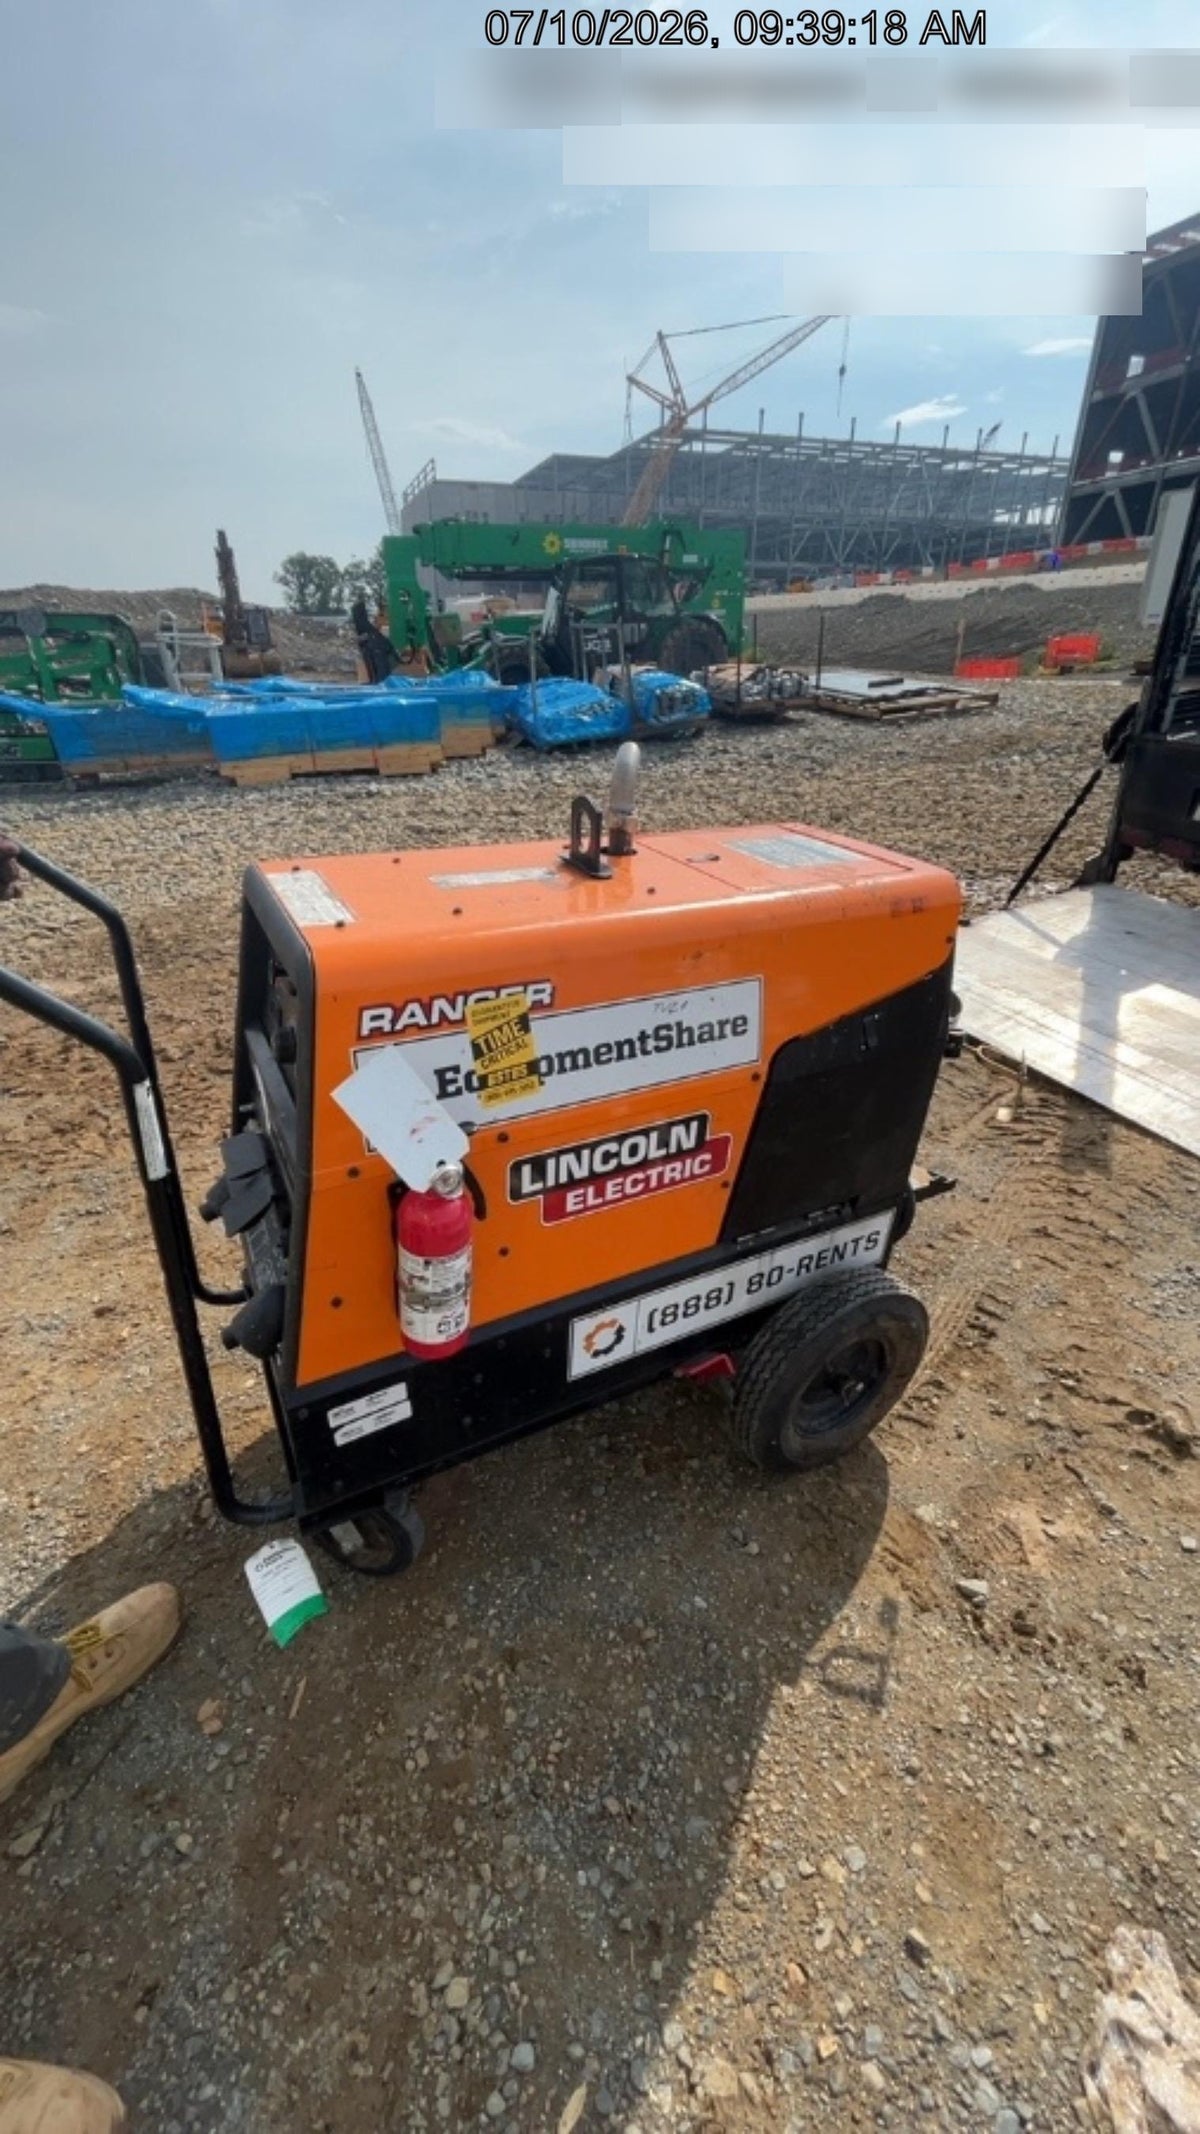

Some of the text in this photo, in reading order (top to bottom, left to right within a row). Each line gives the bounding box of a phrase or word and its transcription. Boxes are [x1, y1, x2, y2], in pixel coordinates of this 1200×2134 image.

[474, 1017, 526, 1056] TIME
[520, 1120, 699, 1195] LINCOLN
[565, 1152, 712, 1213] ELECTRIC
[647, 1230, 882, 1334] (888) 80-RENTS
